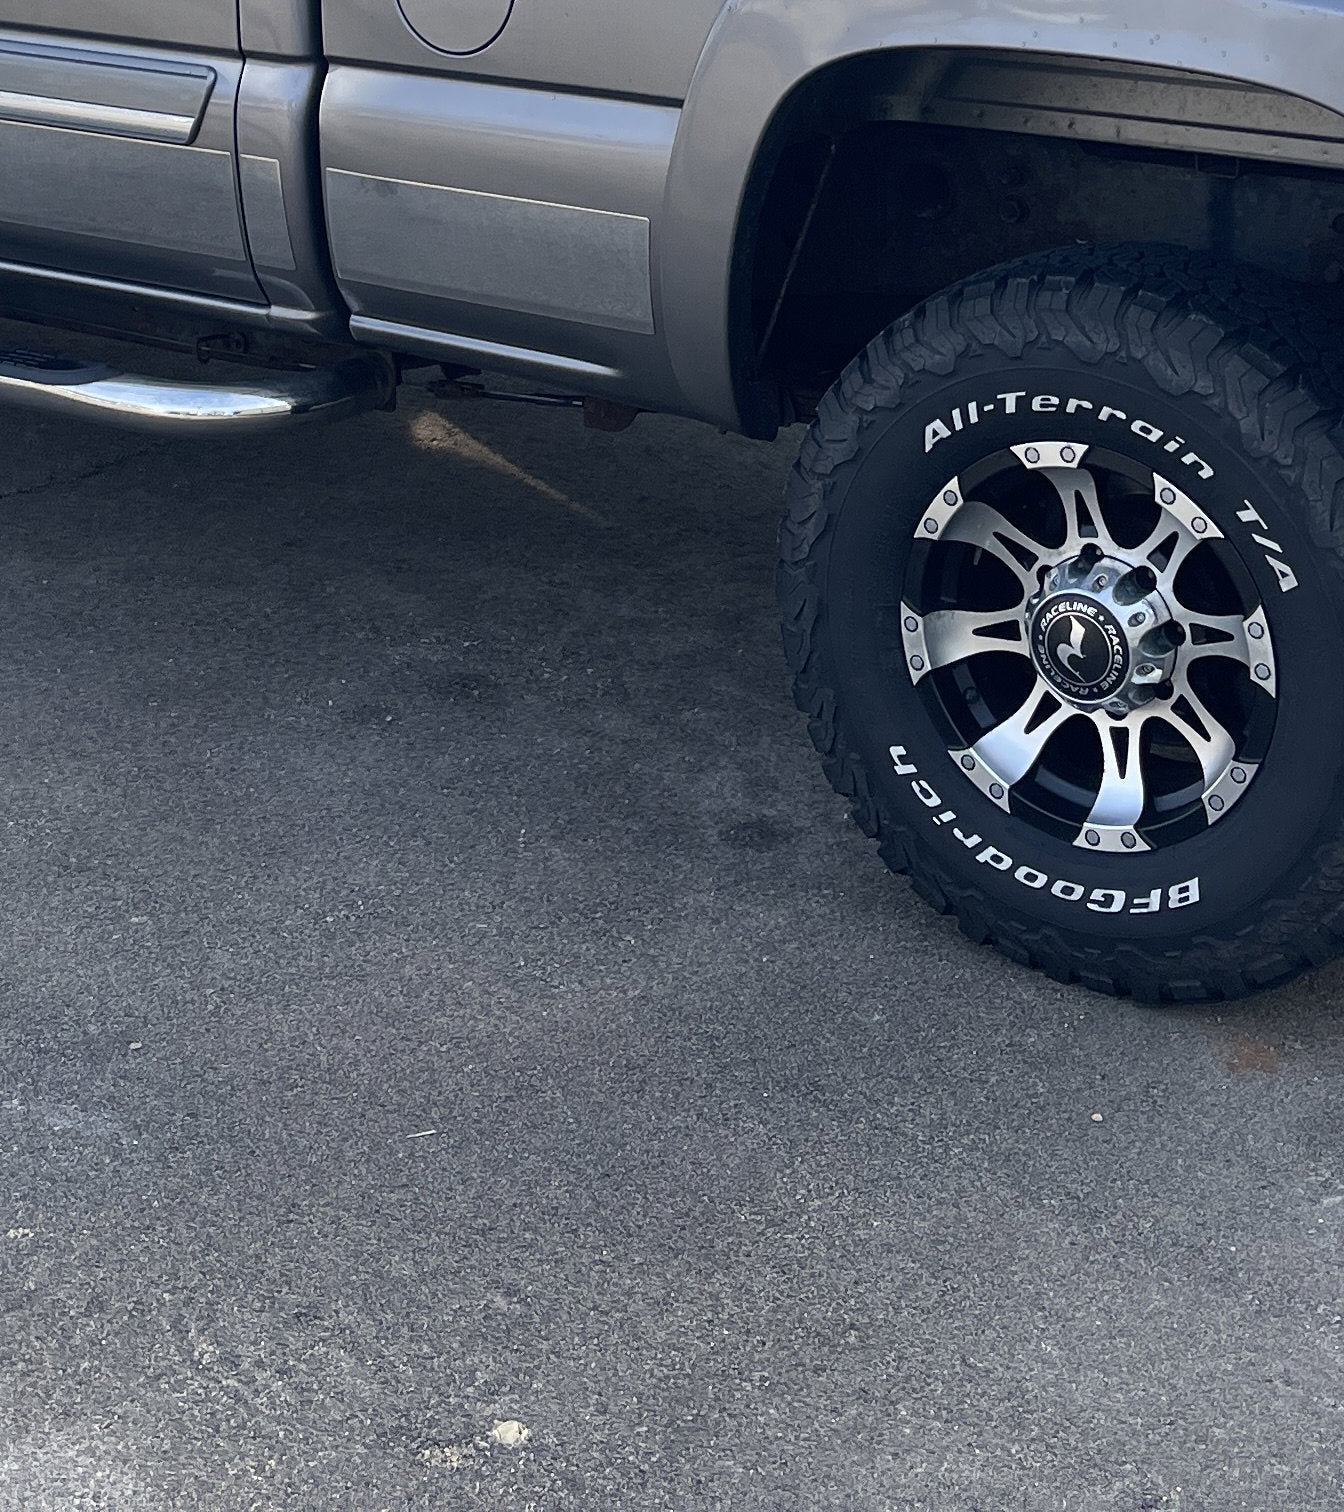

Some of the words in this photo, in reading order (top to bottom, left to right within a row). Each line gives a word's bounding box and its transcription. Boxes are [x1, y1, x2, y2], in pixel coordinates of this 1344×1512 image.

[922, 391, 1217, 480] All-Terrain
[1235, 499, 1300, 594] T/A
[1040, 601, 1098, 632] RACELINE
[1099, 624, 1123, 691] RACELINE
[888, 744, 1202, 915] BFGoodrich
